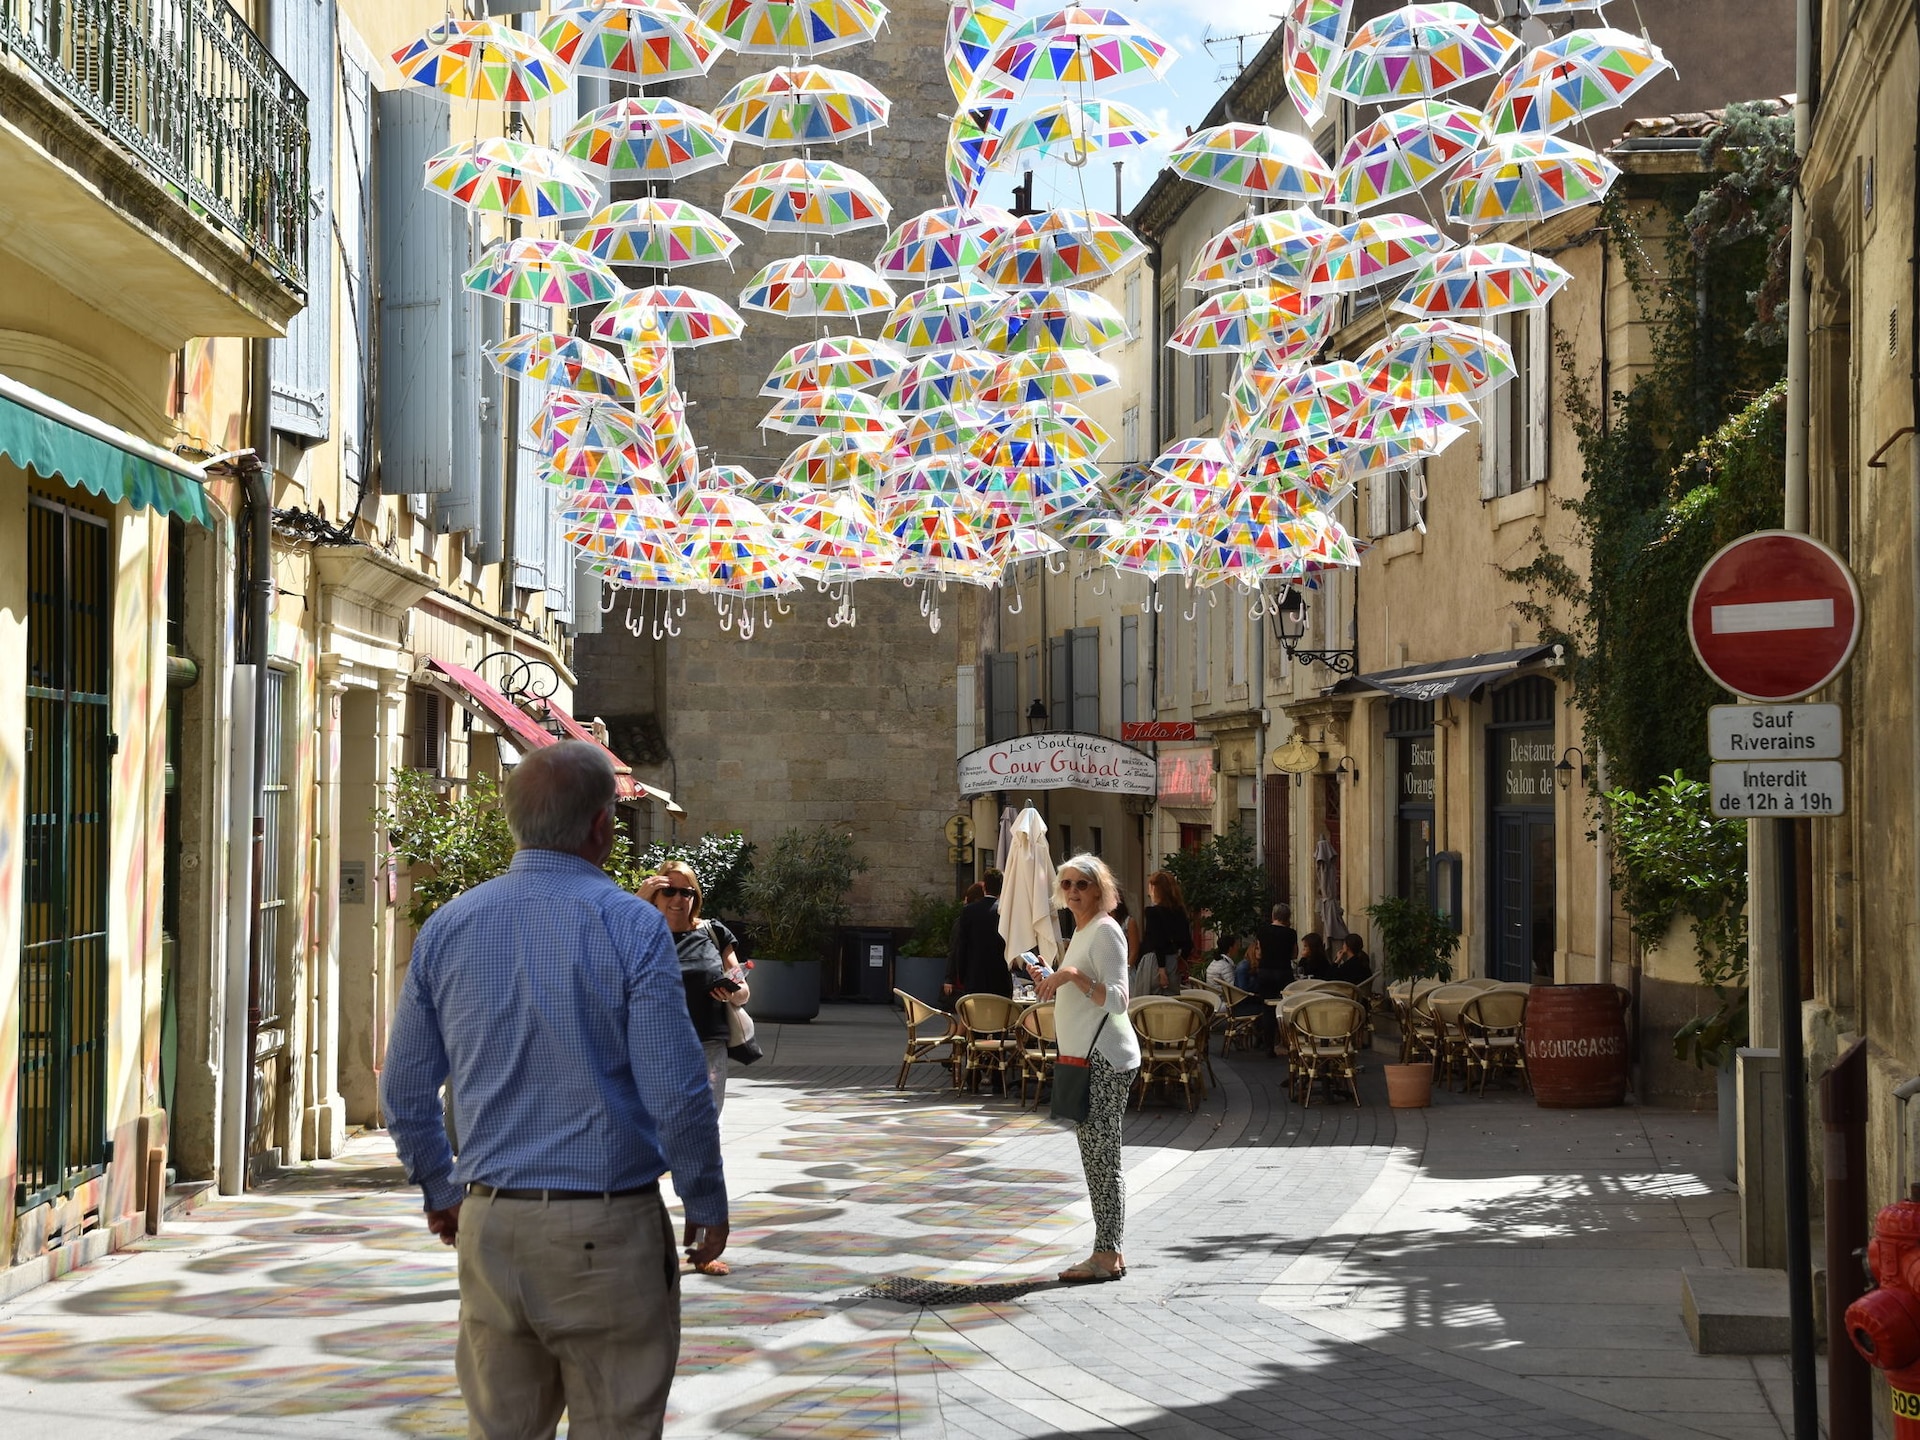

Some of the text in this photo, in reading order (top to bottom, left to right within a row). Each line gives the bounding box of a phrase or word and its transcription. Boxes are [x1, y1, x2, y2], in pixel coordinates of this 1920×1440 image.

[1752, 711, 1794, 728] Sauf
[1125, 722, 1194, 740] Julia R
[1010, 735, 1107, 757] Les Boutiques
[1731, 733, 1815, 750] Riverains
[989, 750, 1121, 777] Cour Guibal
[1506, 769, 1552, 795] Salon de
[1743, 770, 1807, 787] Interdit
[1720, 792, 1832, 810] de 12h à 19h
